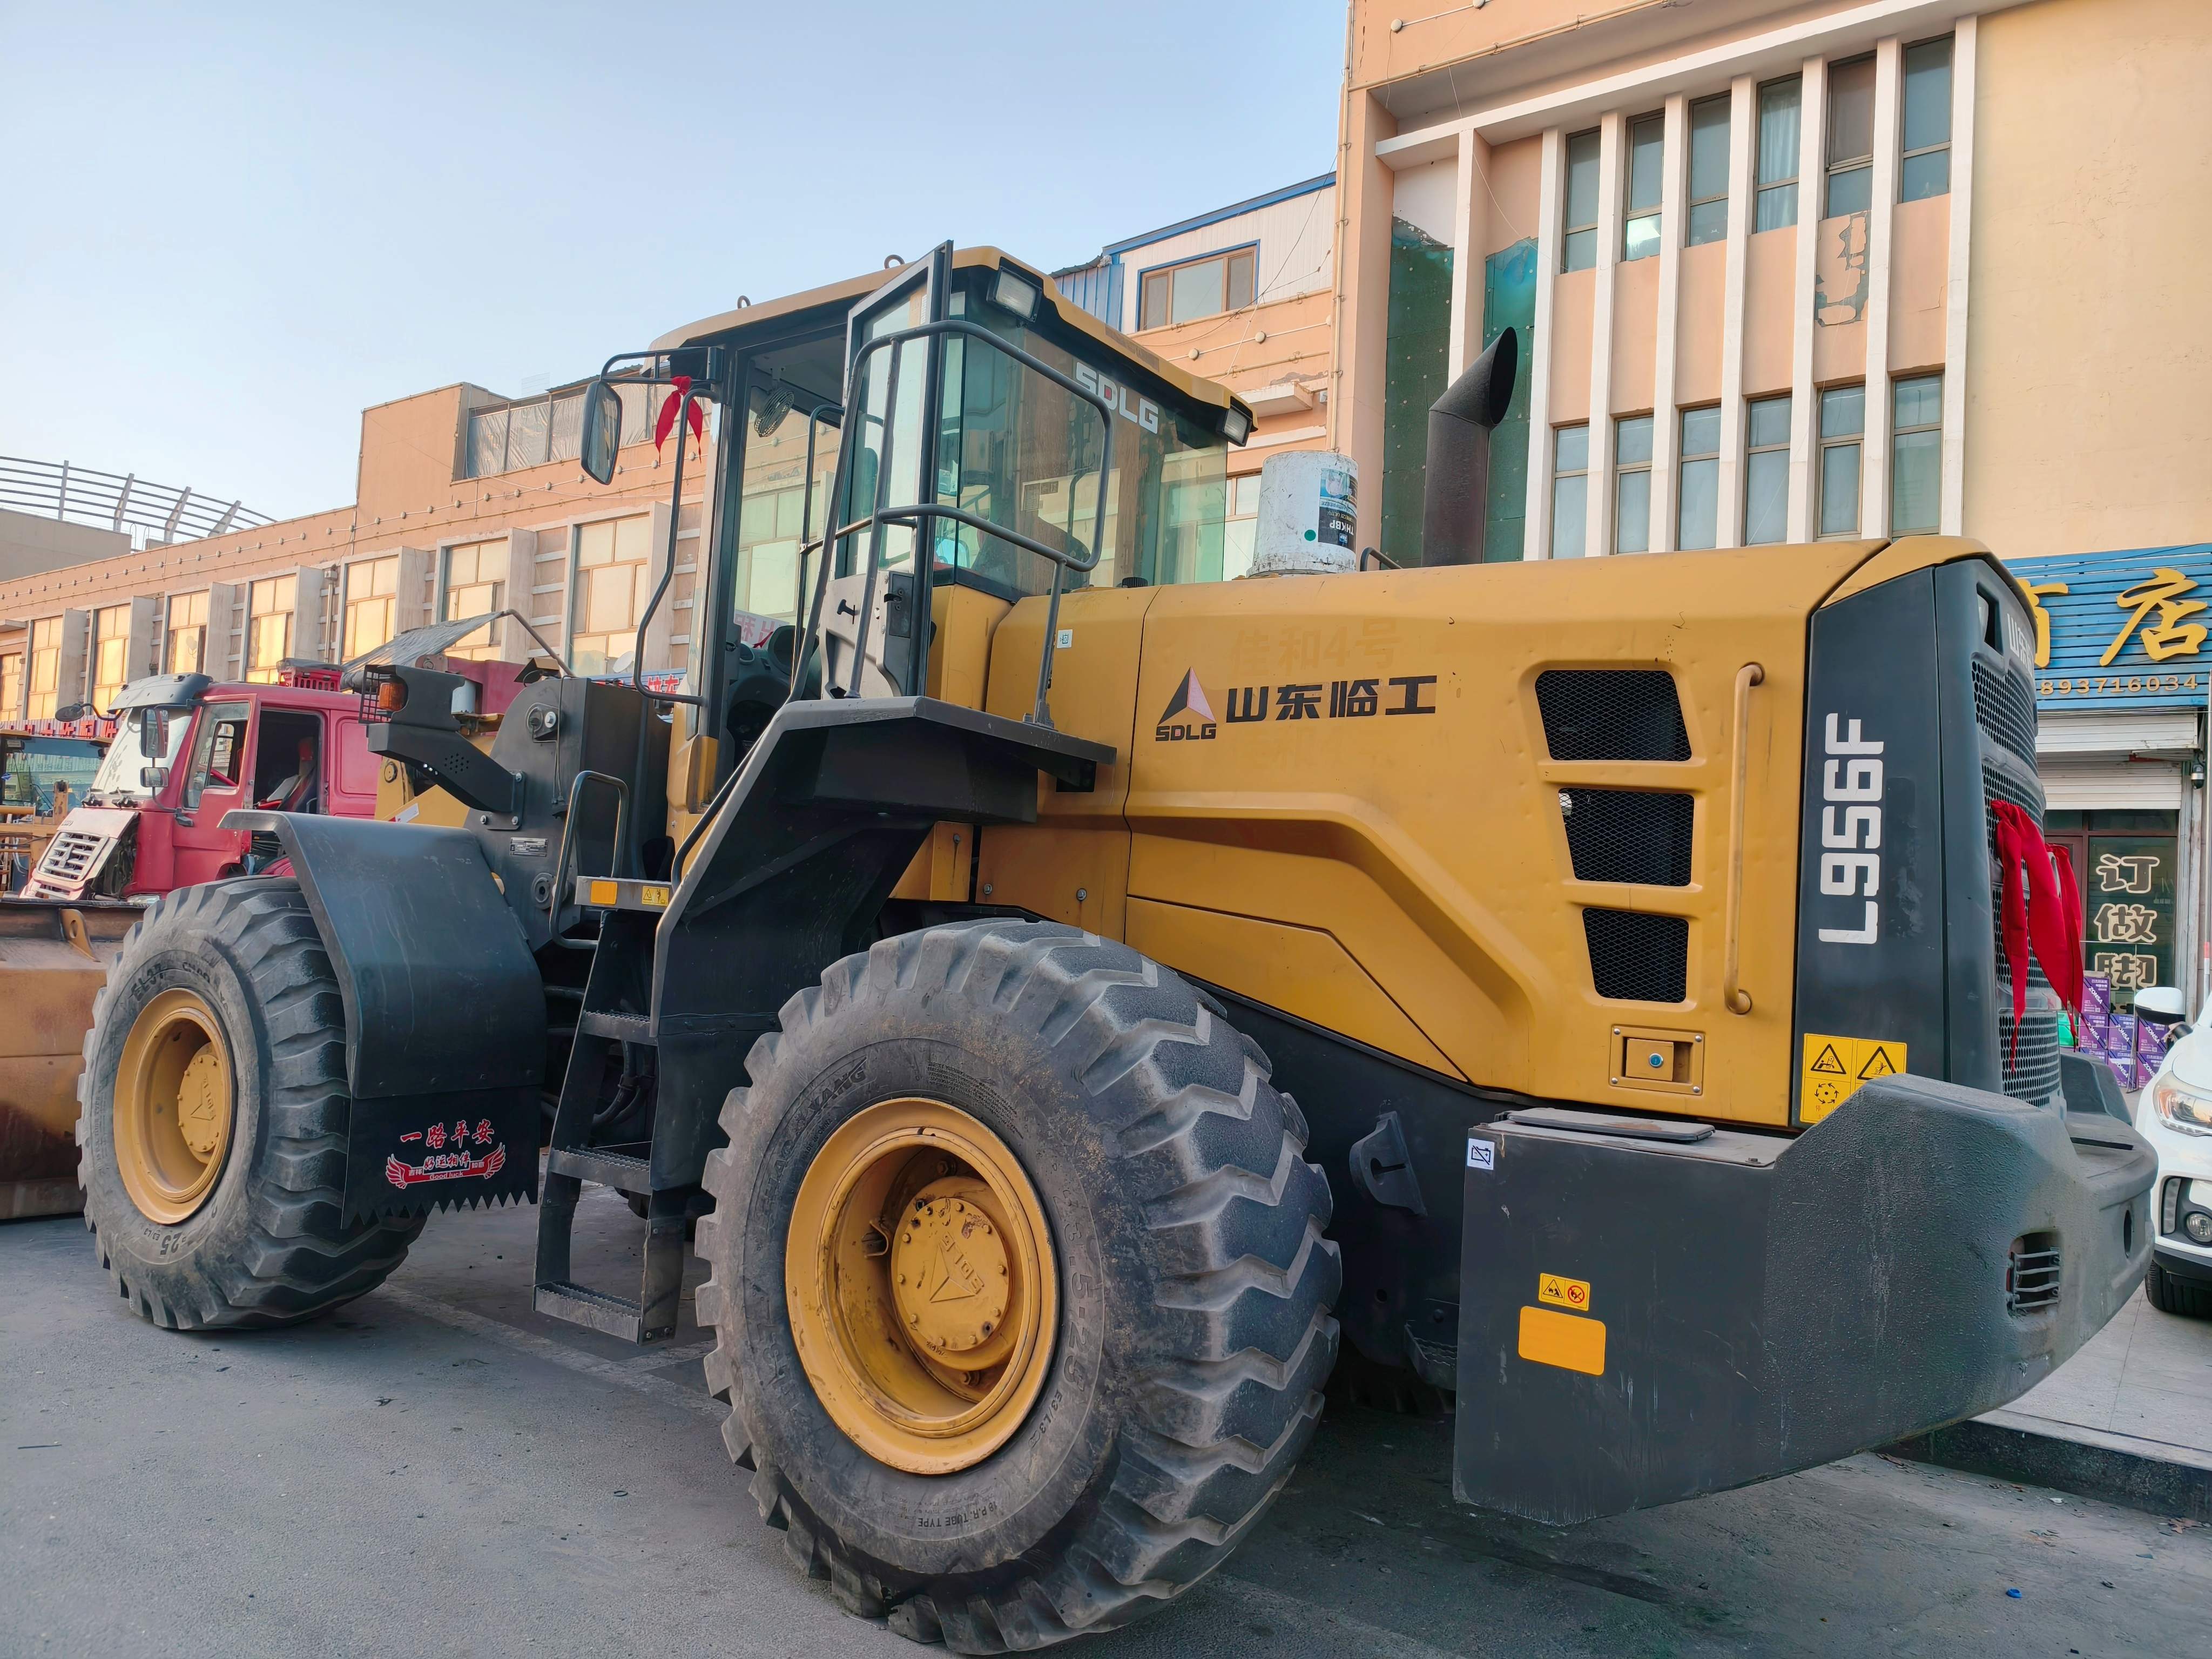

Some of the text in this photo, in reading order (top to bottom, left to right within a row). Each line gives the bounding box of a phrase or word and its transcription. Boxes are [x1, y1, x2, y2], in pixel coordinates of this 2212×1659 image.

[1076, 362, 1158, 434] SDLG
[1226, 675, 1437, 723] 山东临工
[1155, 723, 1217, 741] SDLG
[1818, 713, 1884, 945] L956F
[2088, 986, 2103, 1004] ZONSA
[2086, 1022, 2100, 1041] ZONSA
[2116, 1024, 2129, 1042] ZONSA
[2146, 1026, 2160, 1044] ZONSA
[2143, 1062, 2156, 1077] ZONS
[400, 1119, 495, 1149] 一路平安
[423, 1150, 471, 1171] 好运相伴
[429, 1171, 448, 1180] Good
[1038, 1389, 1063, 1434] E3/L3
[918, 1518, 942, 1527] TYPE
[945, 1513, 969, 1526] TUBE
